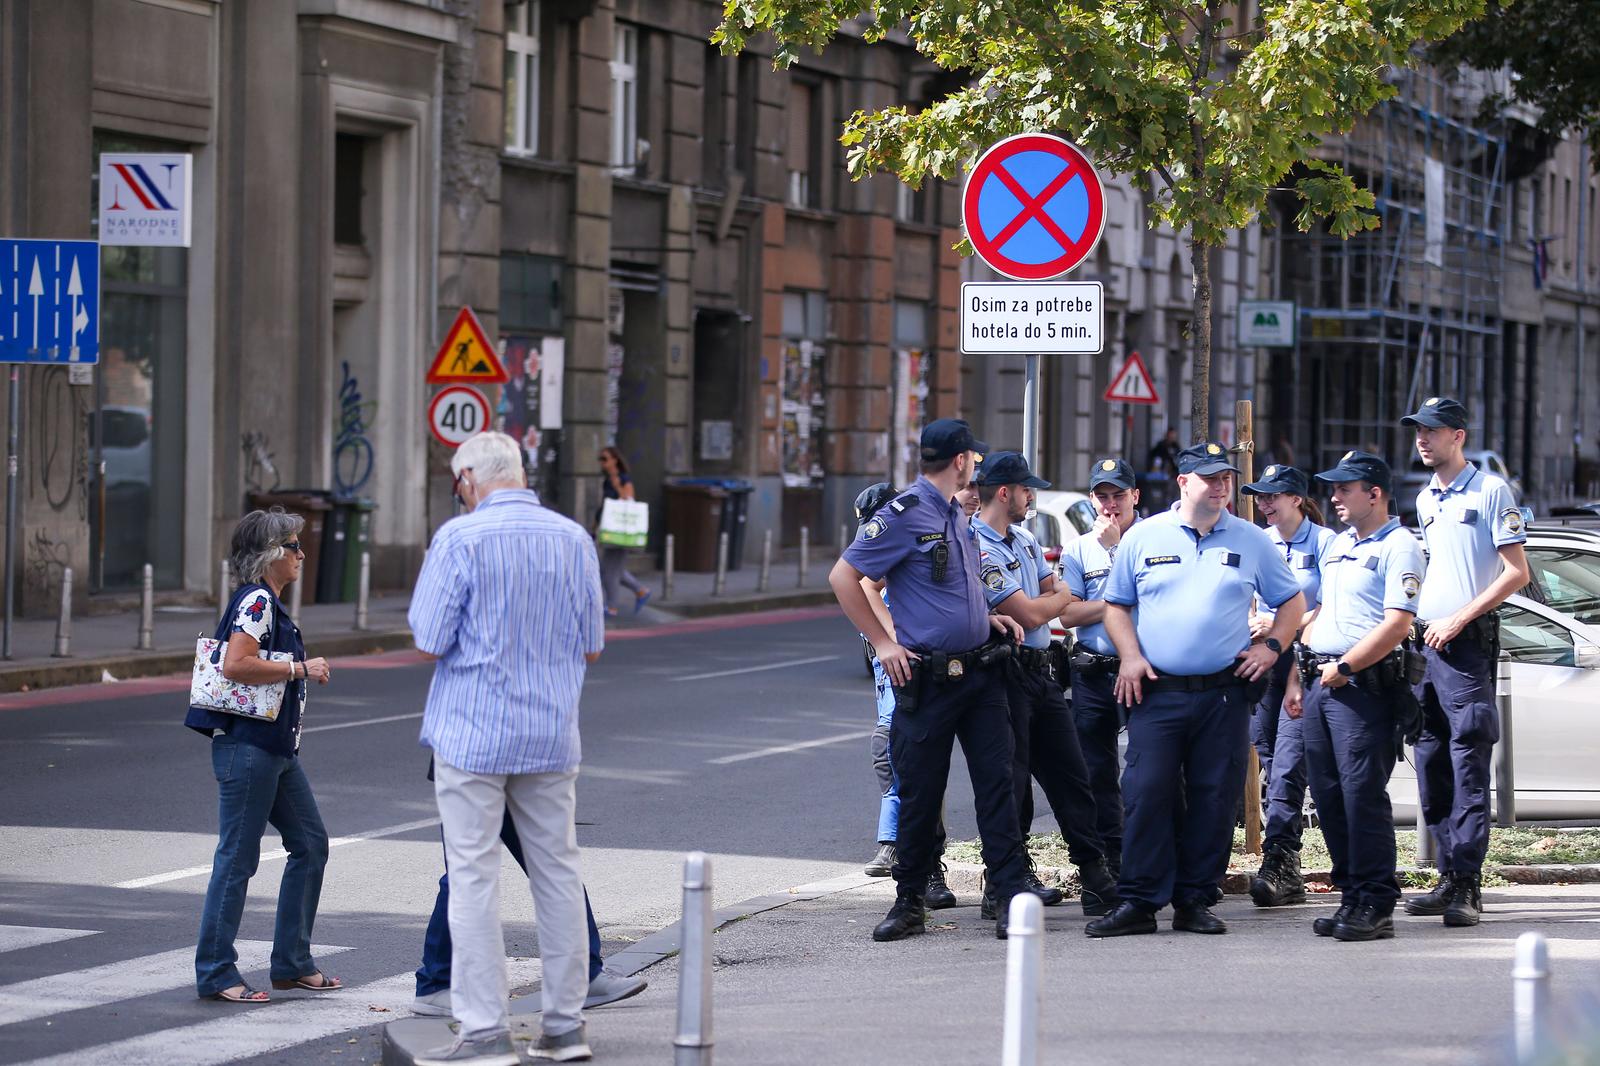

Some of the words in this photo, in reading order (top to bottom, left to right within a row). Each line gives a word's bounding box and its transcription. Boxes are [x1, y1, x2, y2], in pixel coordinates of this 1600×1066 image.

[106, 218, 178, 229] NARODNE
[106, 228, 178, 237] NOVINE
[972, 296, 1006, 312] Osim
[1012, 301, 1029, 312] za
[1036, 296, 1093, 316] potrebe
[972, 322, 1018, 338] hotela
[1024, 322, 1041, 338] do
[1047, 322, 1056, 338] 5
[1061, 322, 1092, 338] min.
[440, 402, 476, 433] 40
